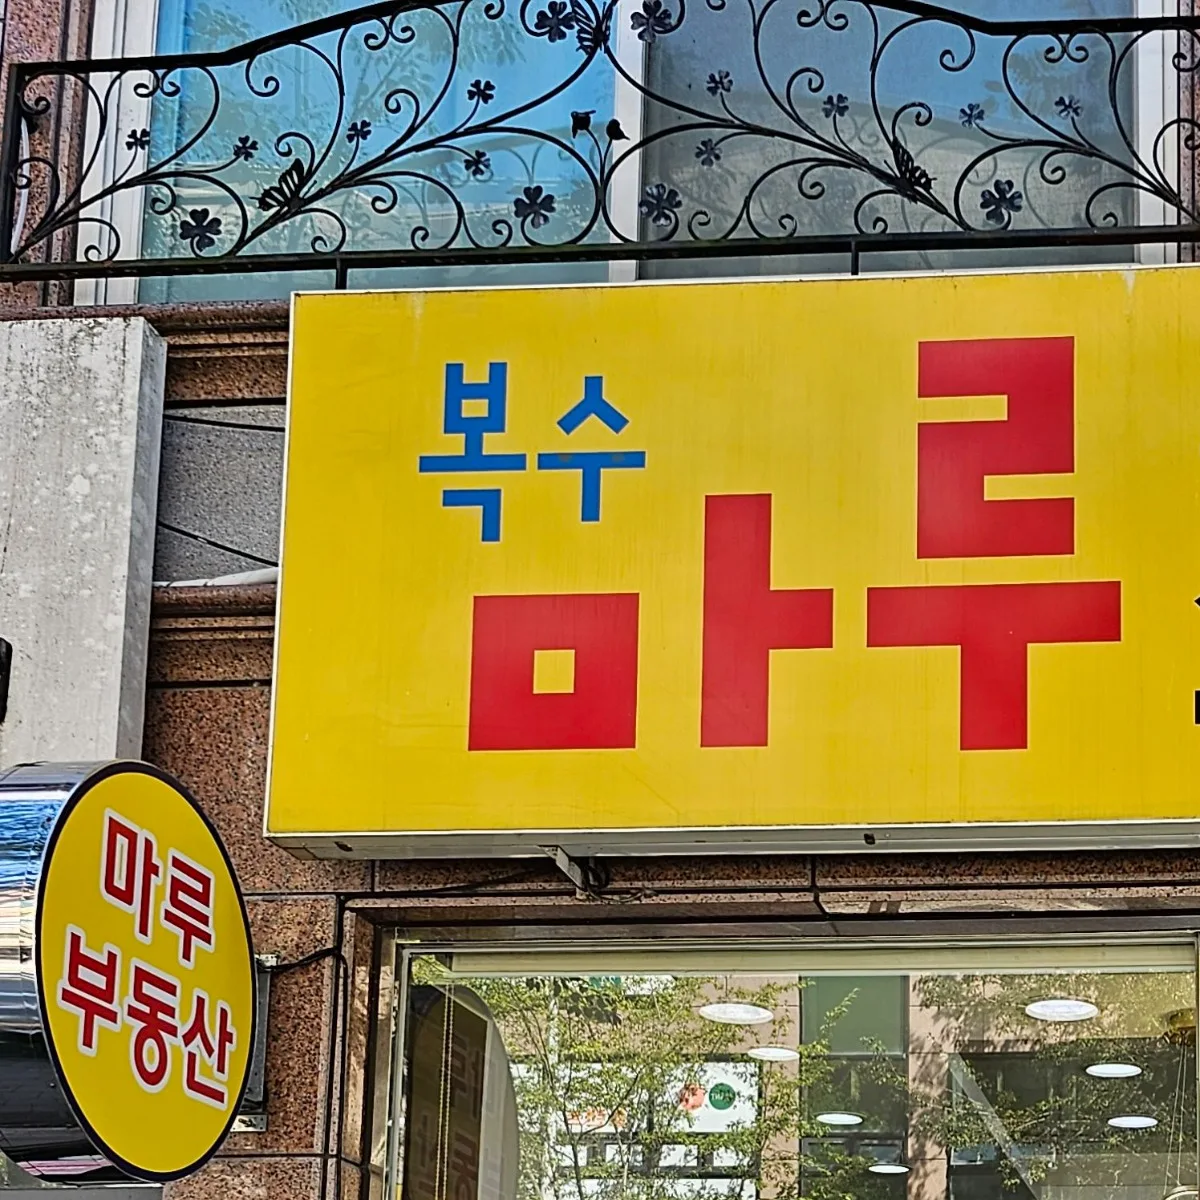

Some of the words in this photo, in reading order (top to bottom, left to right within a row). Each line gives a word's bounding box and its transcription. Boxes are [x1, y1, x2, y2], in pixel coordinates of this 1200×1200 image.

[418, 361, 647, 543] 복수
[467, 335, 1122, 752] 마루
[103, 815, 213, 964] 마루
[60, 930, 234, 1105] 부동산
